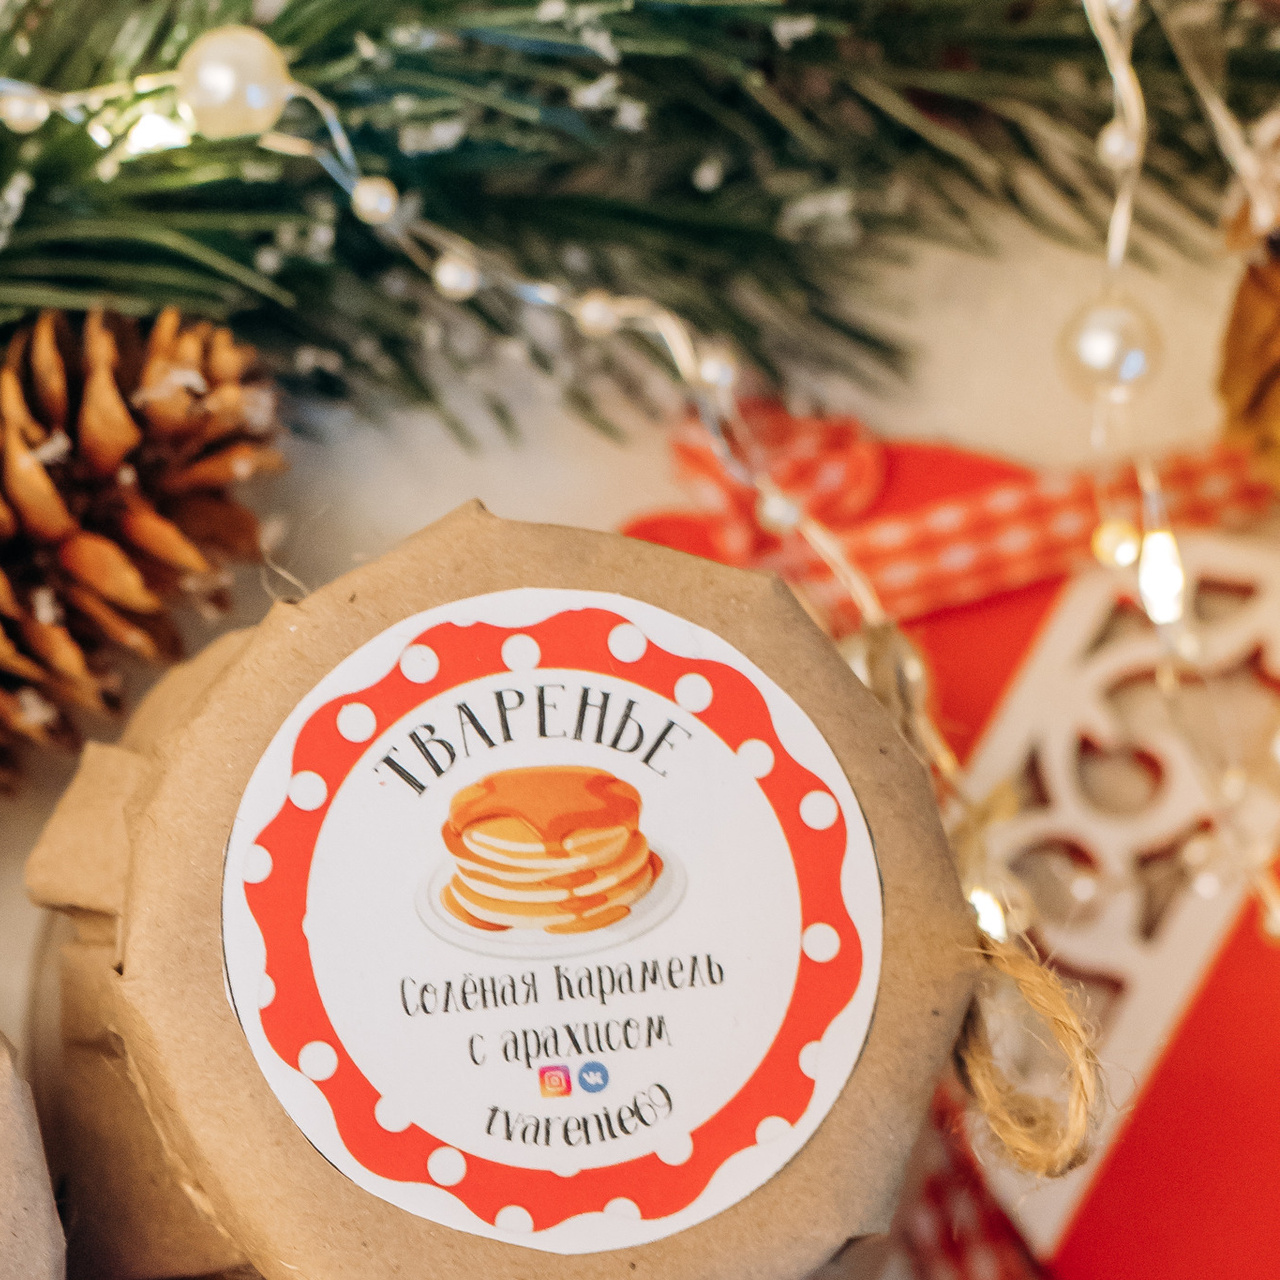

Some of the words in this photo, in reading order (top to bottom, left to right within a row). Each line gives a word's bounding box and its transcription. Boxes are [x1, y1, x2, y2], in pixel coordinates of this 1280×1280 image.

[374, 684, 692, 796] ТВАРЕНЬЕ
[400, 970, 538, 1016] Солёная
[502, 1015, 672, 1069] арахисом
[484, 1083, 673, 1147] tvarenie69
